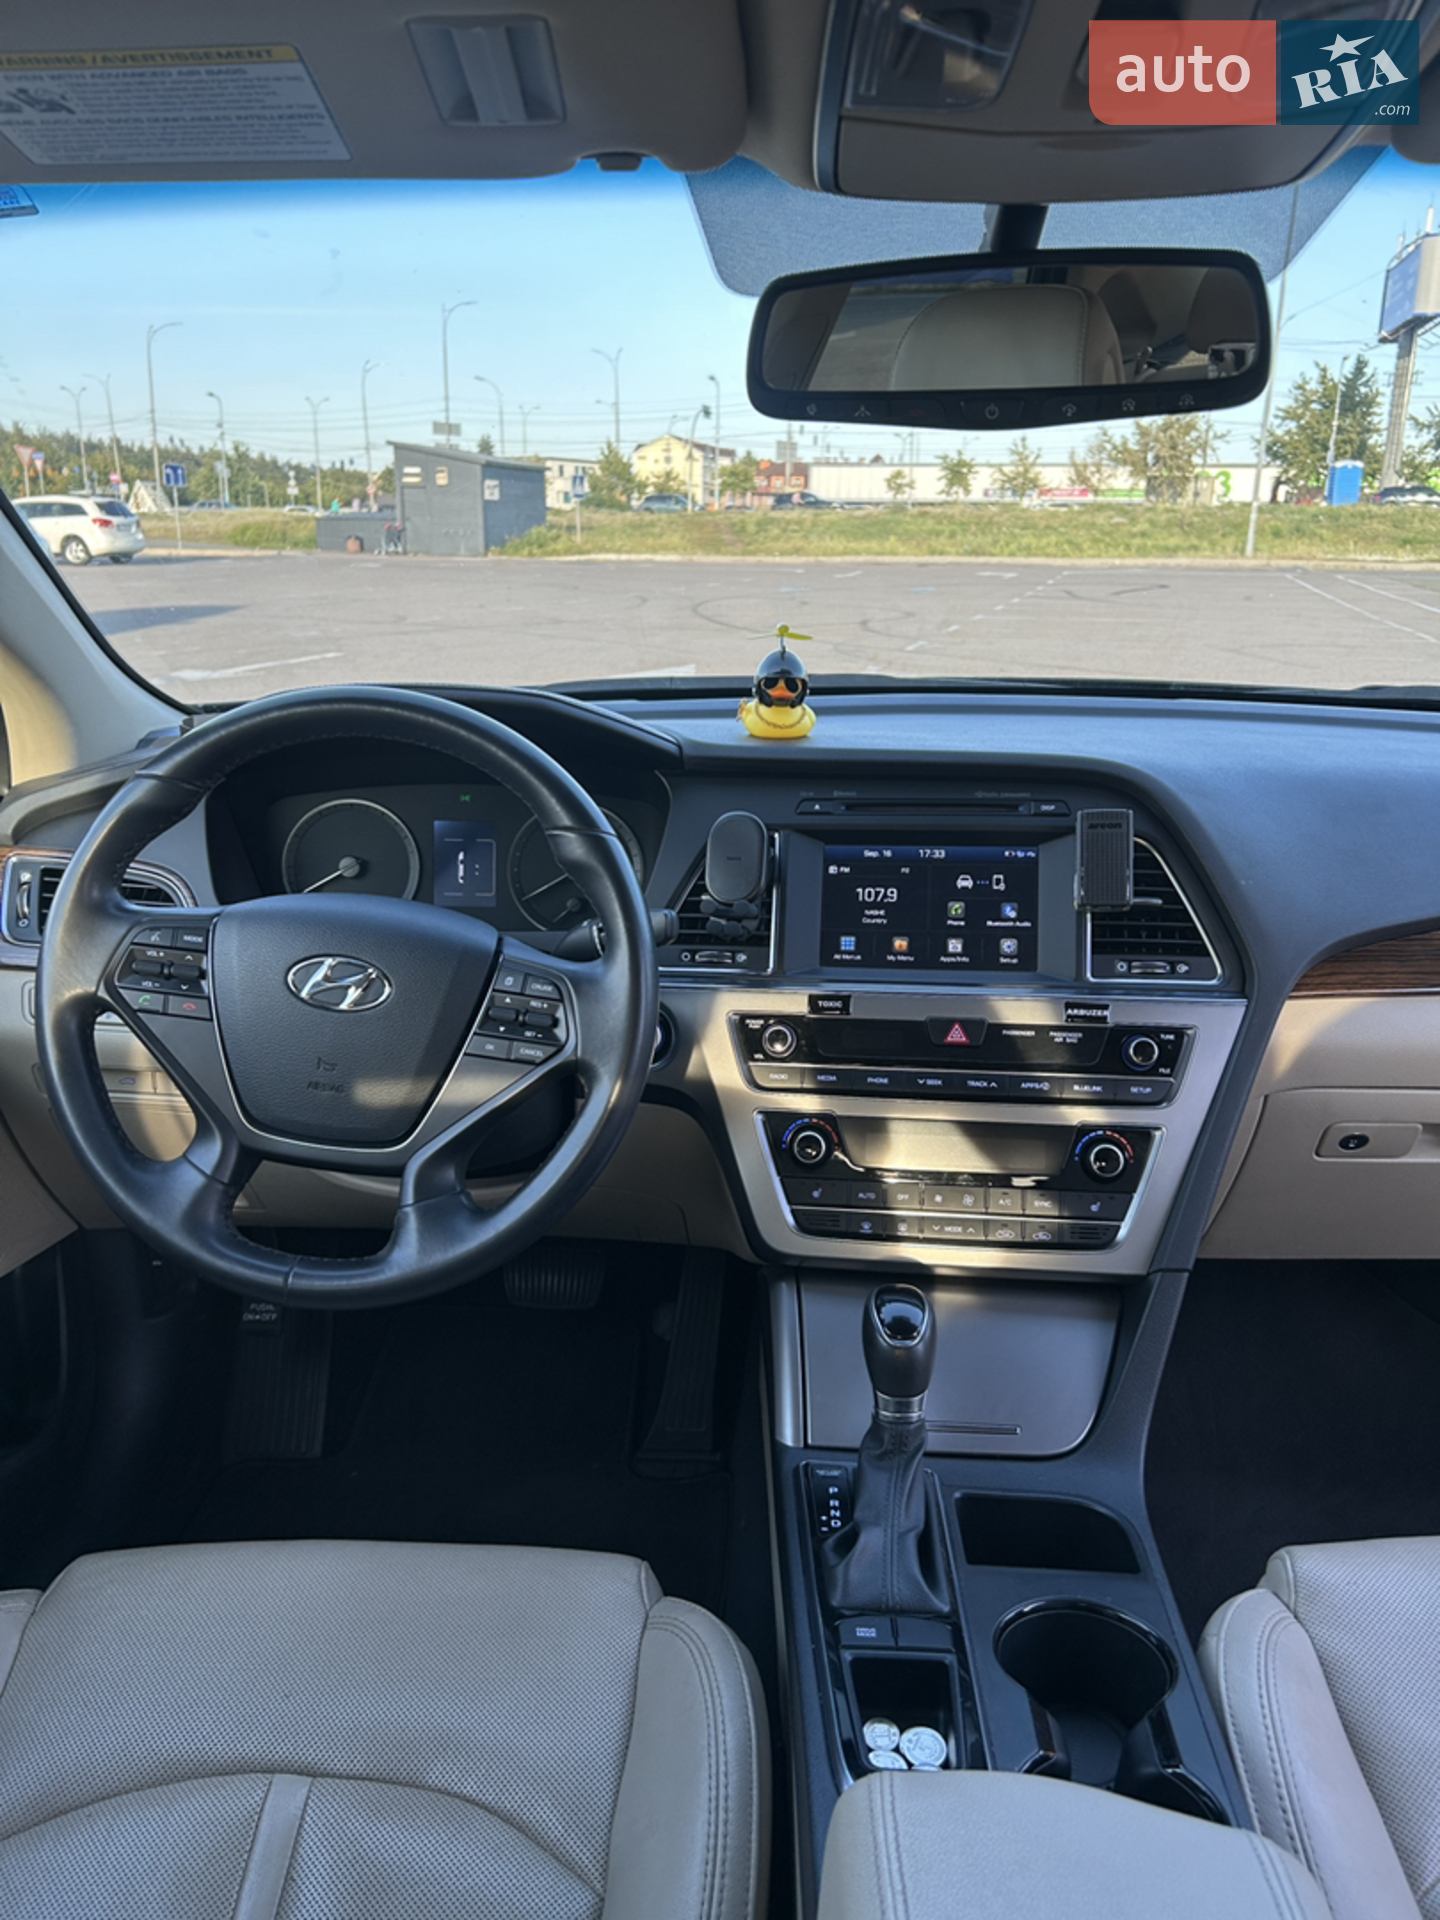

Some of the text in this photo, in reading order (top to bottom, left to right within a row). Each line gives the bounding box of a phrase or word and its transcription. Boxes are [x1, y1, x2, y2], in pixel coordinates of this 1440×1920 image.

[0, 55, 87, 66] ARNING
[1087, 822, 1123, 830] areon
[856, 887, 898, 902] 107.9
[817, 1000, 843, 1008] TOXIC
[817, 1074, 838, 1082] MEDIA
[866, 1076, 889, 1085] PHONE
[926, 1078, 943, 1086] SEEK
[966, 1080, 989, 1088] TRACK
[1130, 1086, 1153, 1094] SETUP
[858, 1192, 876, 1200] AUTO
[1034, 1200, 1052, 1208] SYNC
[828, 1486, 839, 1495] P
[829, 1508, 841, 1517] N
[830, 1519, 842, 1528] D
